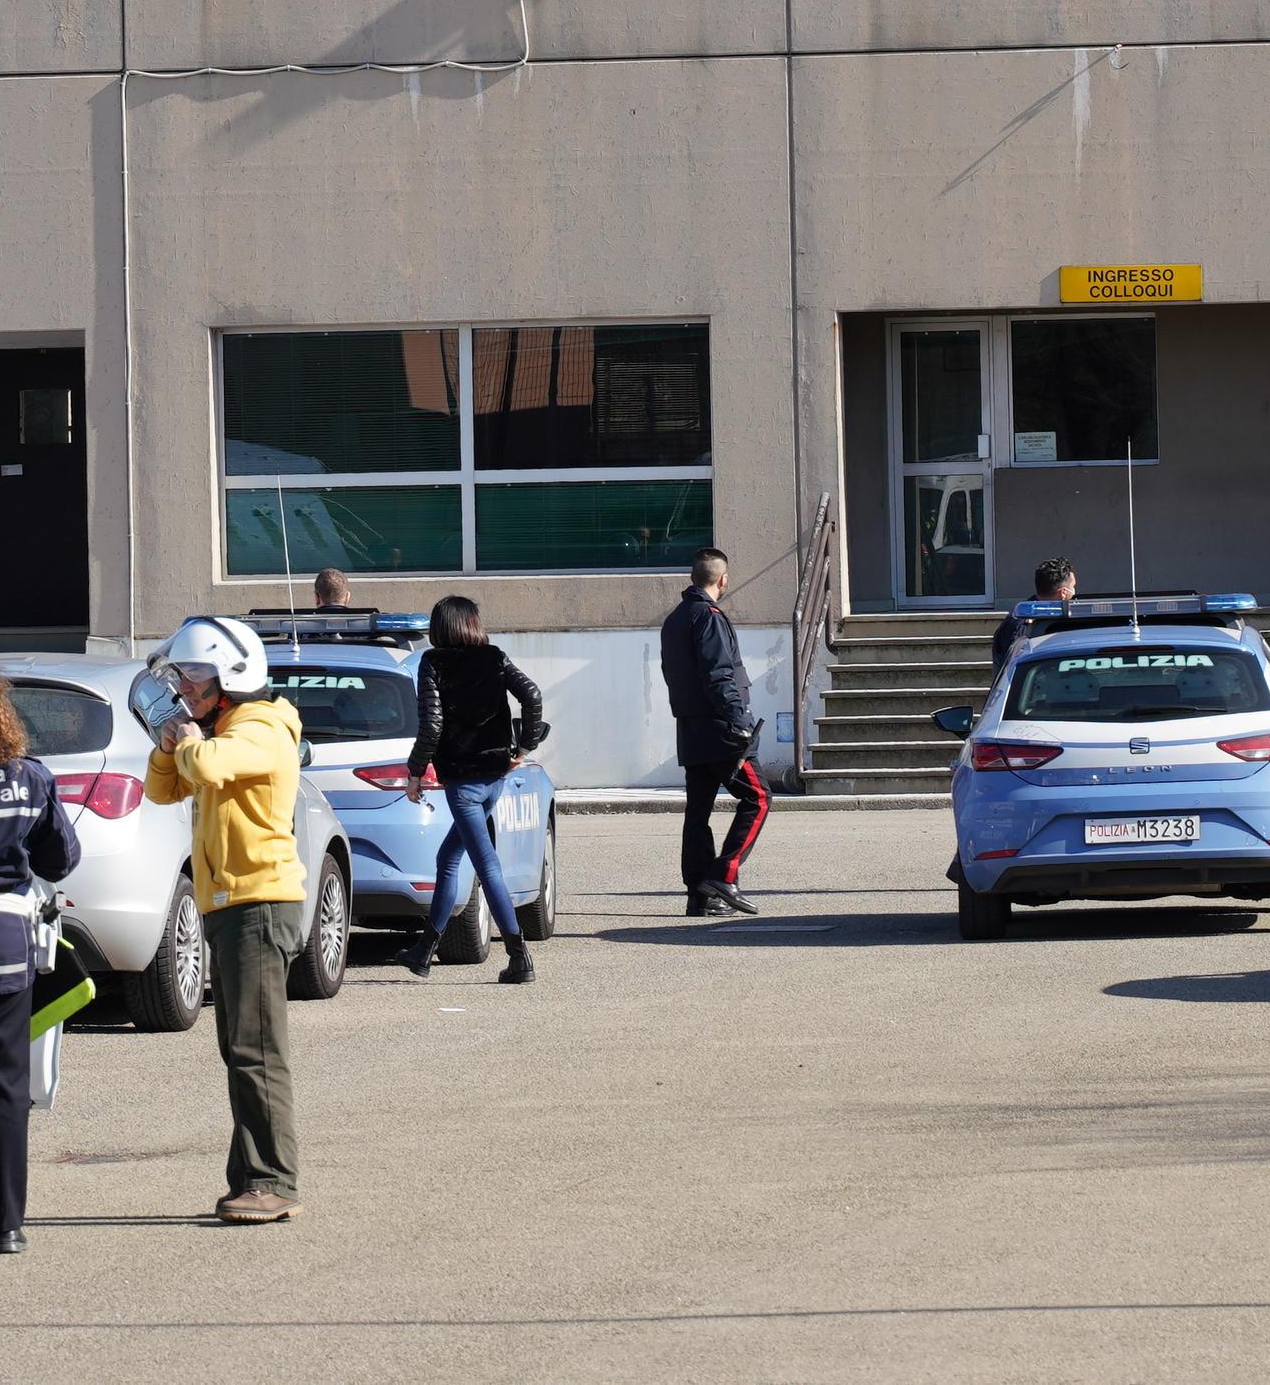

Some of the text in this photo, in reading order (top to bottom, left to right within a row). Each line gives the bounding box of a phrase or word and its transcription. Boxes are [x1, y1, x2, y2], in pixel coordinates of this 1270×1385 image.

[1087, 268, 1174, 282] INGRESSO
[1089, 284, 1173, 298] COLLOQUI
[1058, 654, 1215, 672] POLIZIA
[267, 676, 366, 689] LIZIA
[1108, 765, 1173, 775] LEON
[1090, 819, 1195, 839] POLIZIA M3238
